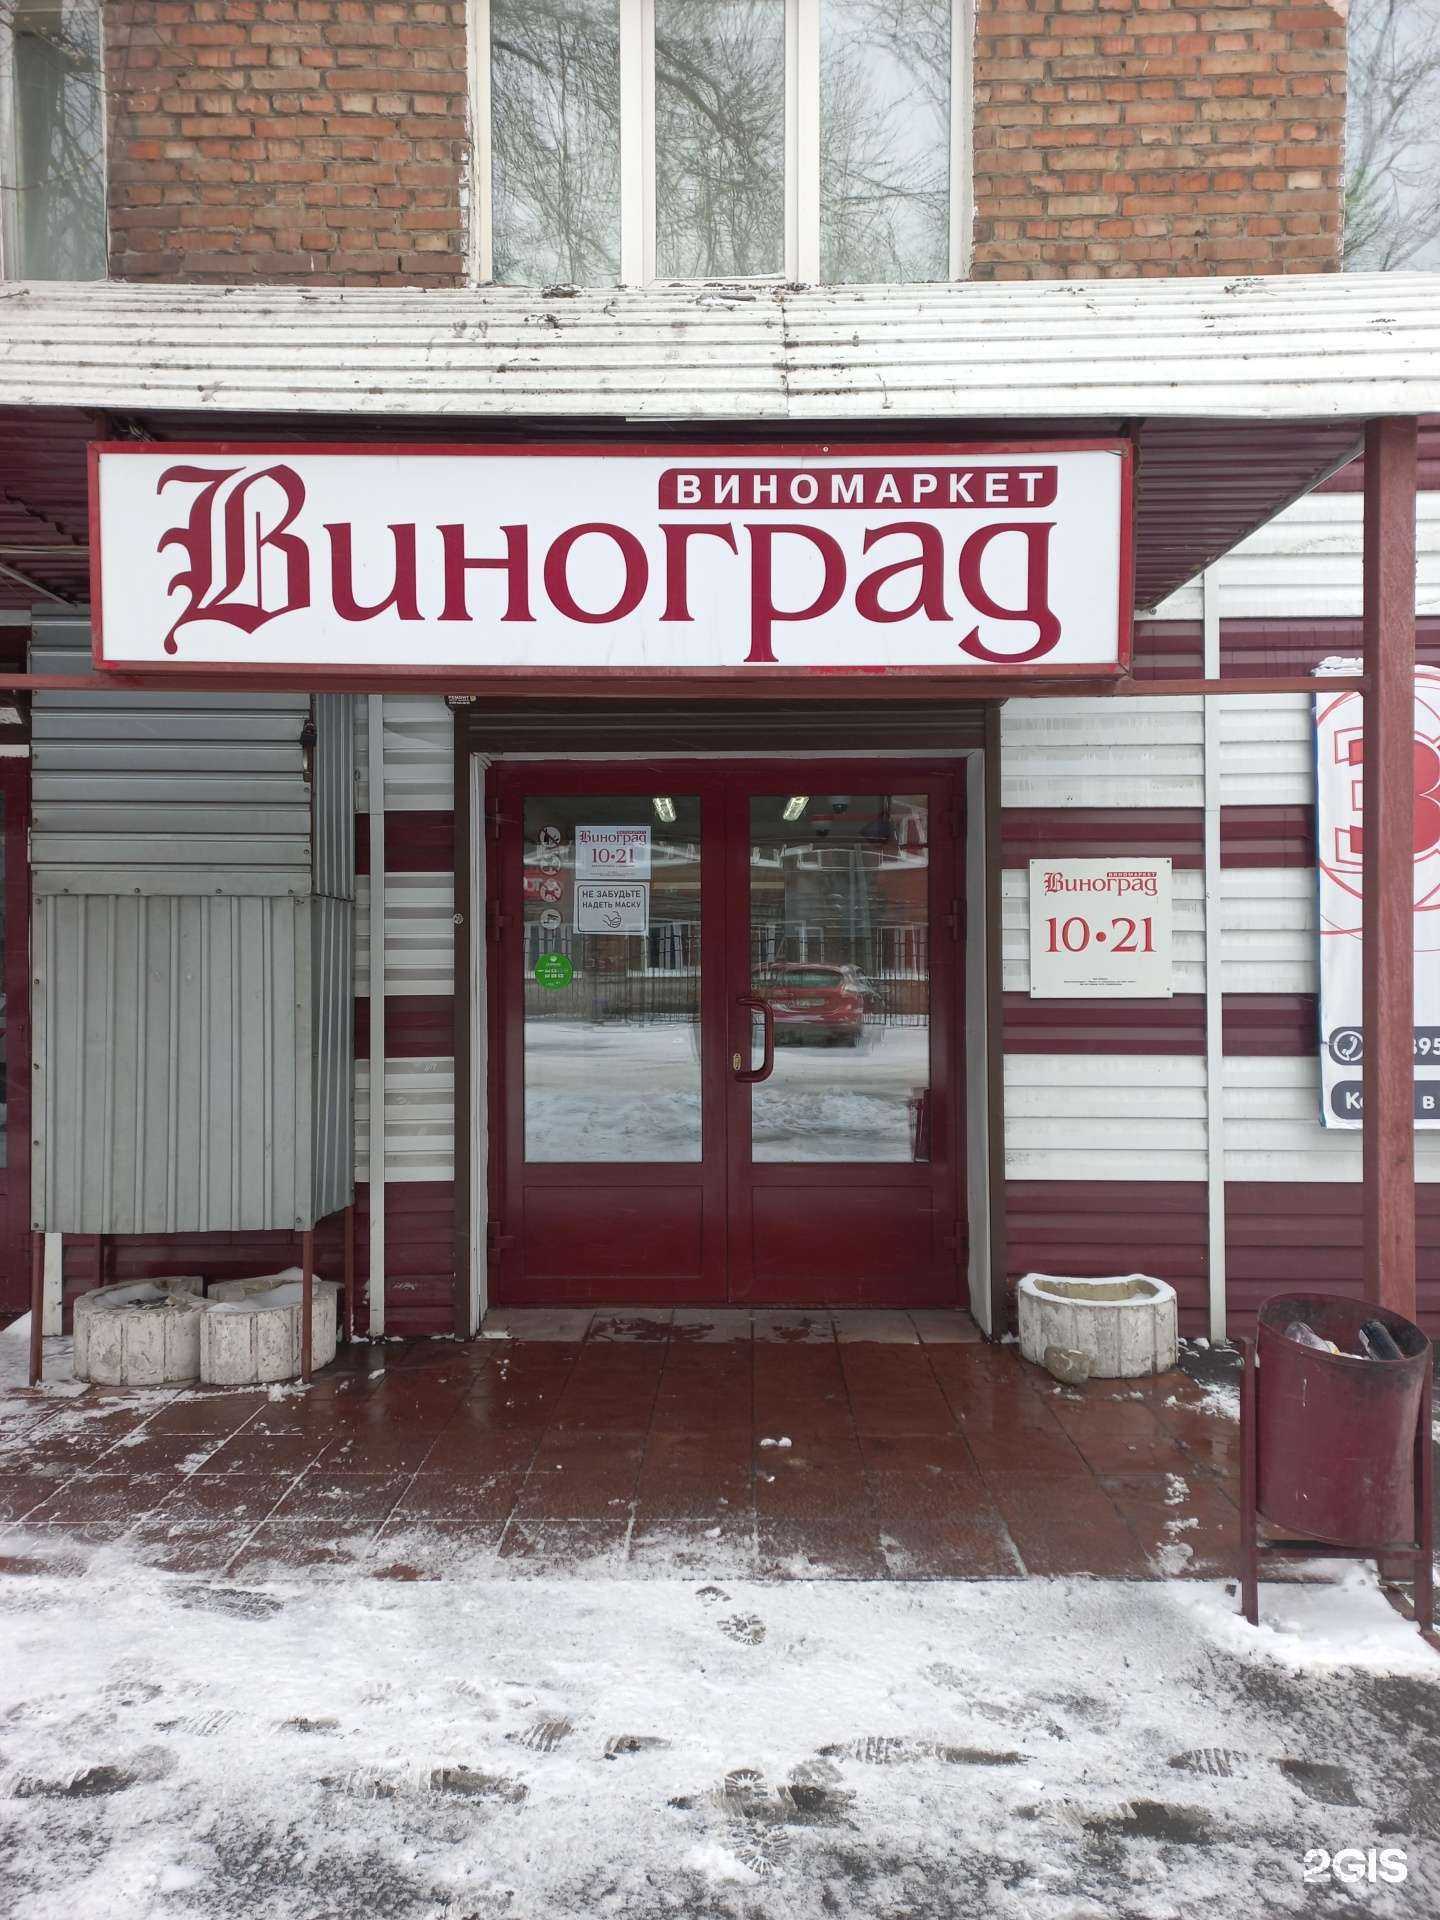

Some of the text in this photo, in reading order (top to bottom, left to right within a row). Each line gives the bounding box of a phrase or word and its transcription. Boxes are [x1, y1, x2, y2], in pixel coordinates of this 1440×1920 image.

[676, 472, 1044, 505] ВИНОМАРКЕТ
[156, 464, 1062, 664] Виноград
[579, 831, 647, 846] Виноград
[1043, 872, 1158, 896] Виноград
[582, 890, 641, 899] НЕ ЗАБУДЬТЕ
[582, 901, 641, 909] НАДЕТЬ МАСКУ
